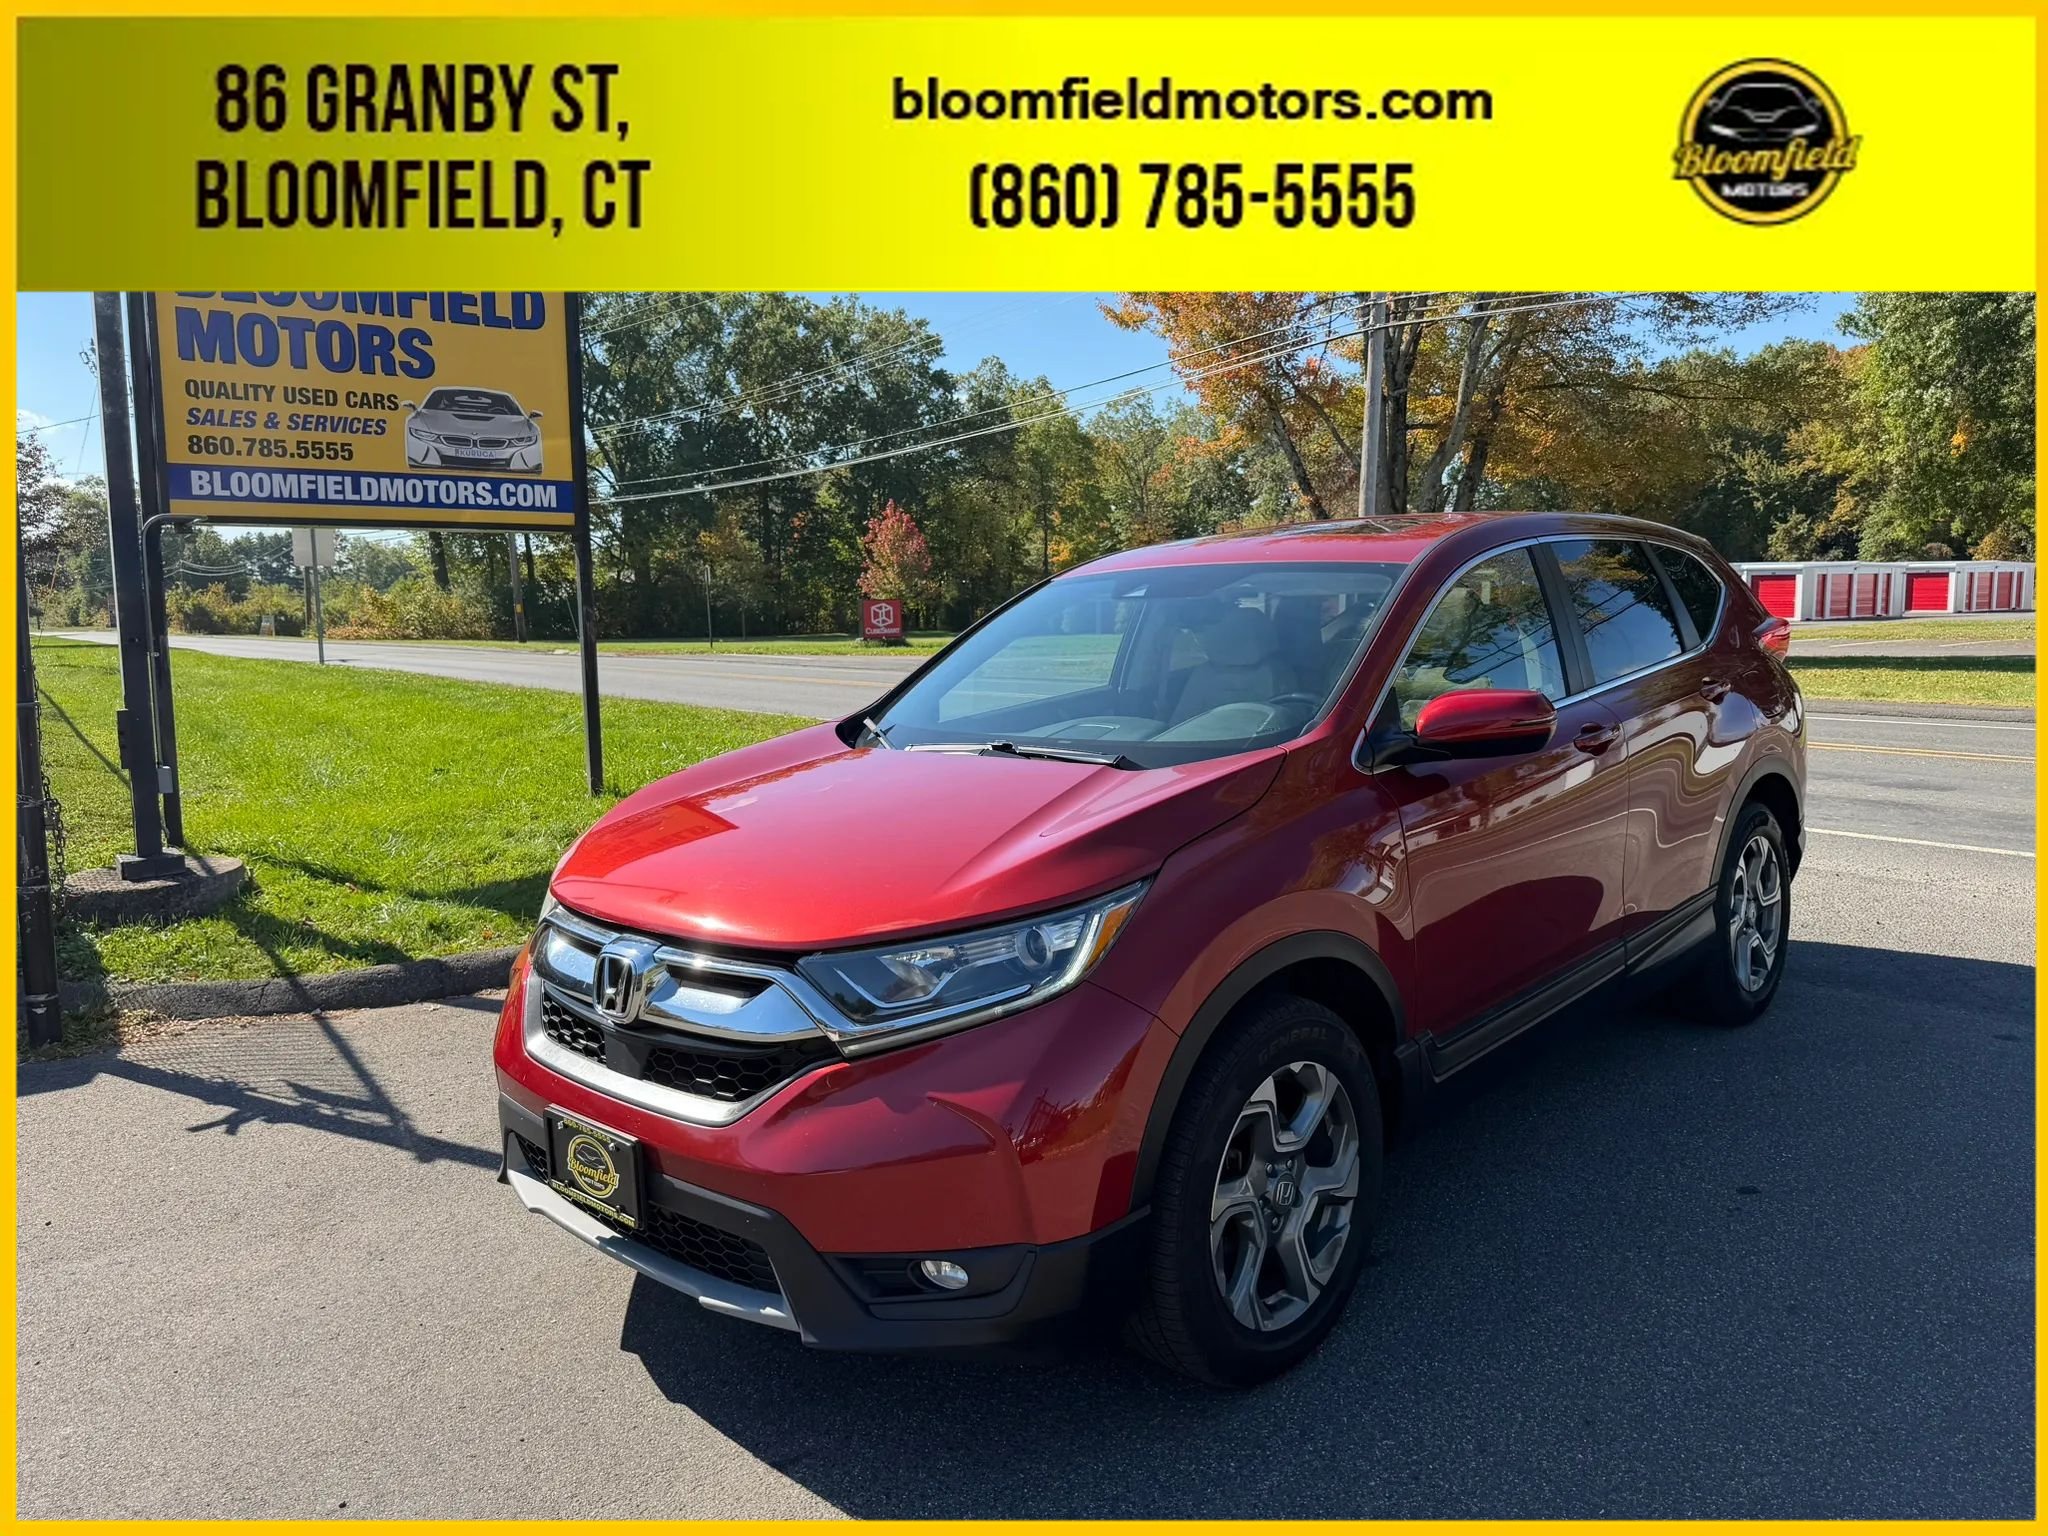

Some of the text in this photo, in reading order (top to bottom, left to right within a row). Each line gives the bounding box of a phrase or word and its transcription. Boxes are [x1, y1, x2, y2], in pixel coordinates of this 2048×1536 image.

[175, 291, 546, 330] MFIELD
[175, 306, 436, 379] MOTORS
[185, 379, 399, 411] QUALITY USED CARS
[186, 407, 387, 435] SALES & SERVICES
[187, 434, 354, 461] 860.785.5555
[190, 470, 557, 508] BLOOMFIELDMOTORS.COM
[570, 1159, 618, 1186] Bloomfield
[552, 1181, 635, 1227] BLOOMFIELDMOTORS.COM
